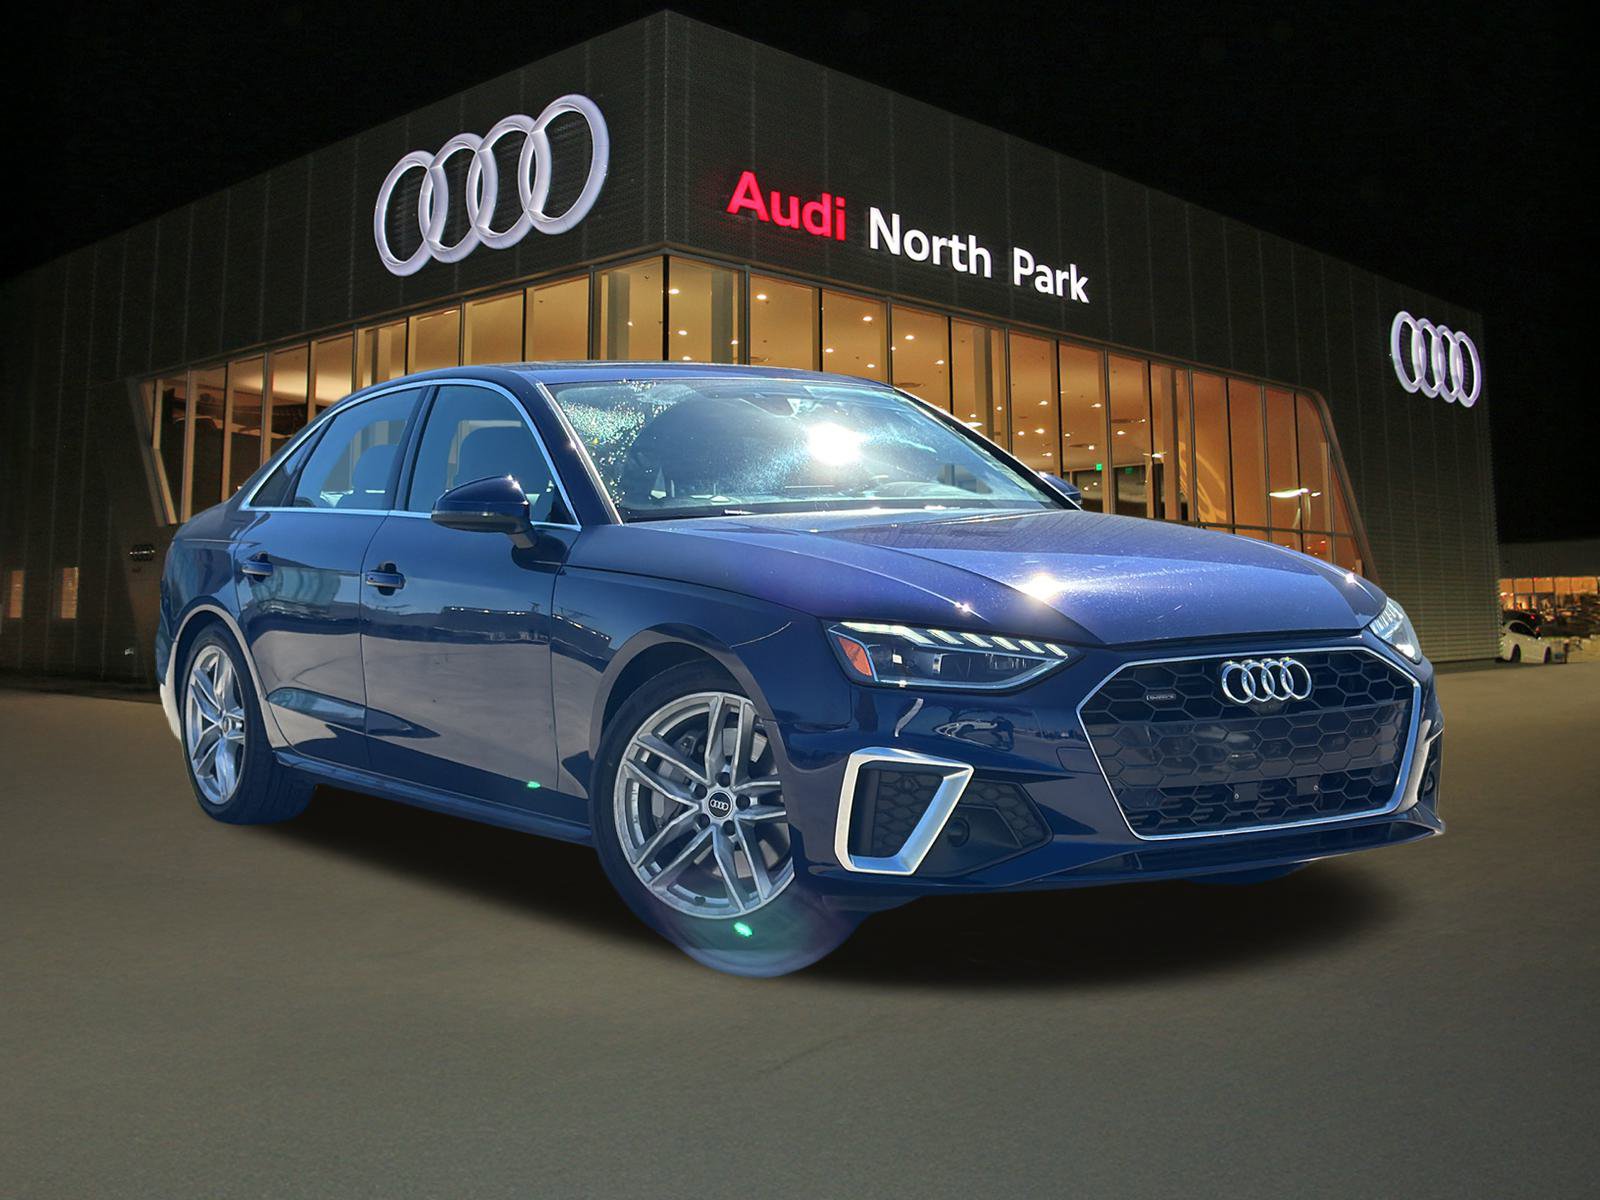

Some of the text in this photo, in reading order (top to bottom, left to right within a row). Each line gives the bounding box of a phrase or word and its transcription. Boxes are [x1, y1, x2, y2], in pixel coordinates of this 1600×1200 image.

[726, 171, 1090, 304] Audi North Park
